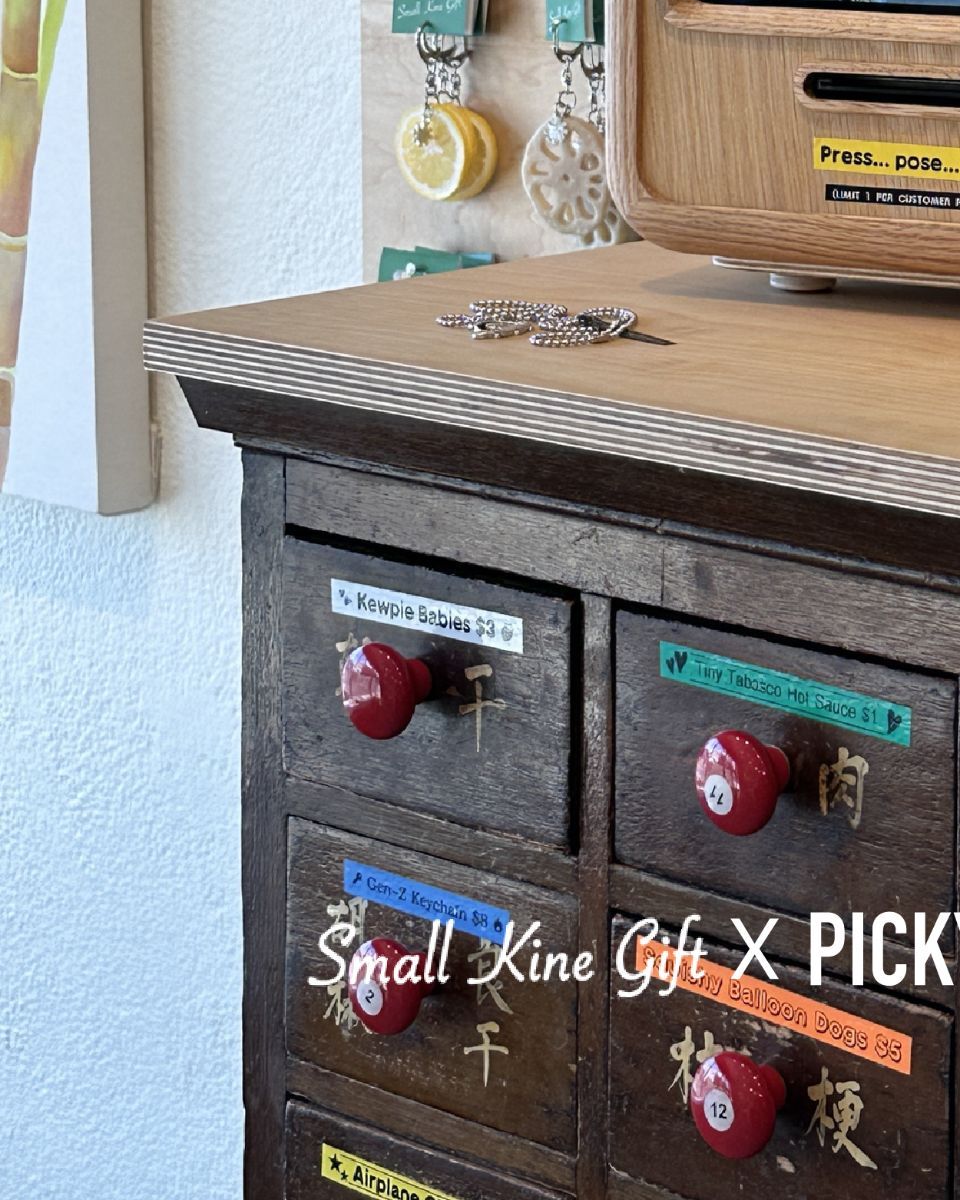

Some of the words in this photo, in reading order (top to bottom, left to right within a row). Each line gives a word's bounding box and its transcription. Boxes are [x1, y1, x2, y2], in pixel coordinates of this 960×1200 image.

[820, 145, 890, 168] Press...
[895, 154, 960, 175] pose...
[876, 192, 893, 203] PER
[898, 194, 951, 206] CUSTOMER
[356, 592, 415, 621] Kewpie
[418, 605, 471, 634] Babies
[475, 615, 496, 638] $3
[695, 660, 723, 684] Tiny
[787, 680, 809, 704] Hot
[814, 693, 857, 719] Sauce
[861, 706, 879, 725] $1
[366, 876, 407, 902] Gen-Z
[411, 890, 468, 922] Keychain
[472, 910, 488, 928] $8
[364, 990, 375, 1004] 2
[730, 979, 808, 1028] Balloon
[814, 1010, 869, 1050] Dogs
[874, 1034, 903, 1063] $5
[710, 1102, 728, 1119] 12
